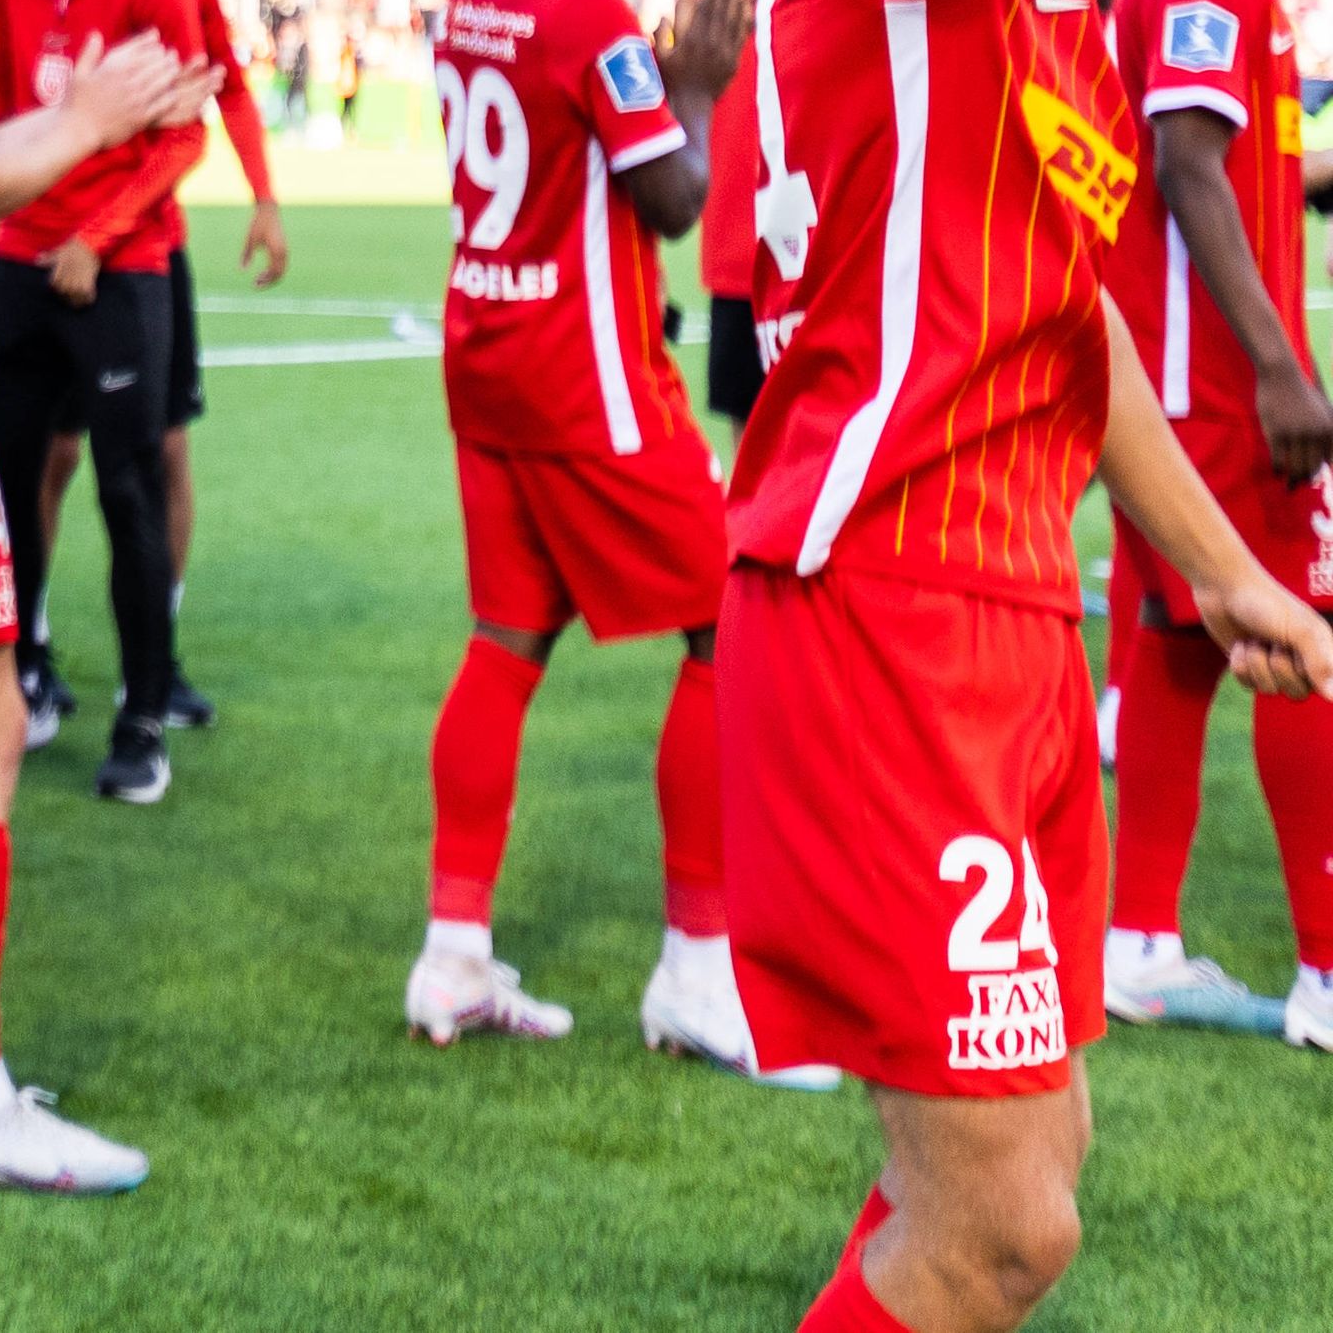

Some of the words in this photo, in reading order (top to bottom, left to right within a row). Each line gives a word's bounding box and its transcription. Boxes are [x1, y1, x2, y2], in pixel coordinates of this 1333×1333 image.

[939, 834, 1058, 971] 24
[969, 969, 1063, 1017] FAX
[948, 1018, 1066, 1069] KON
